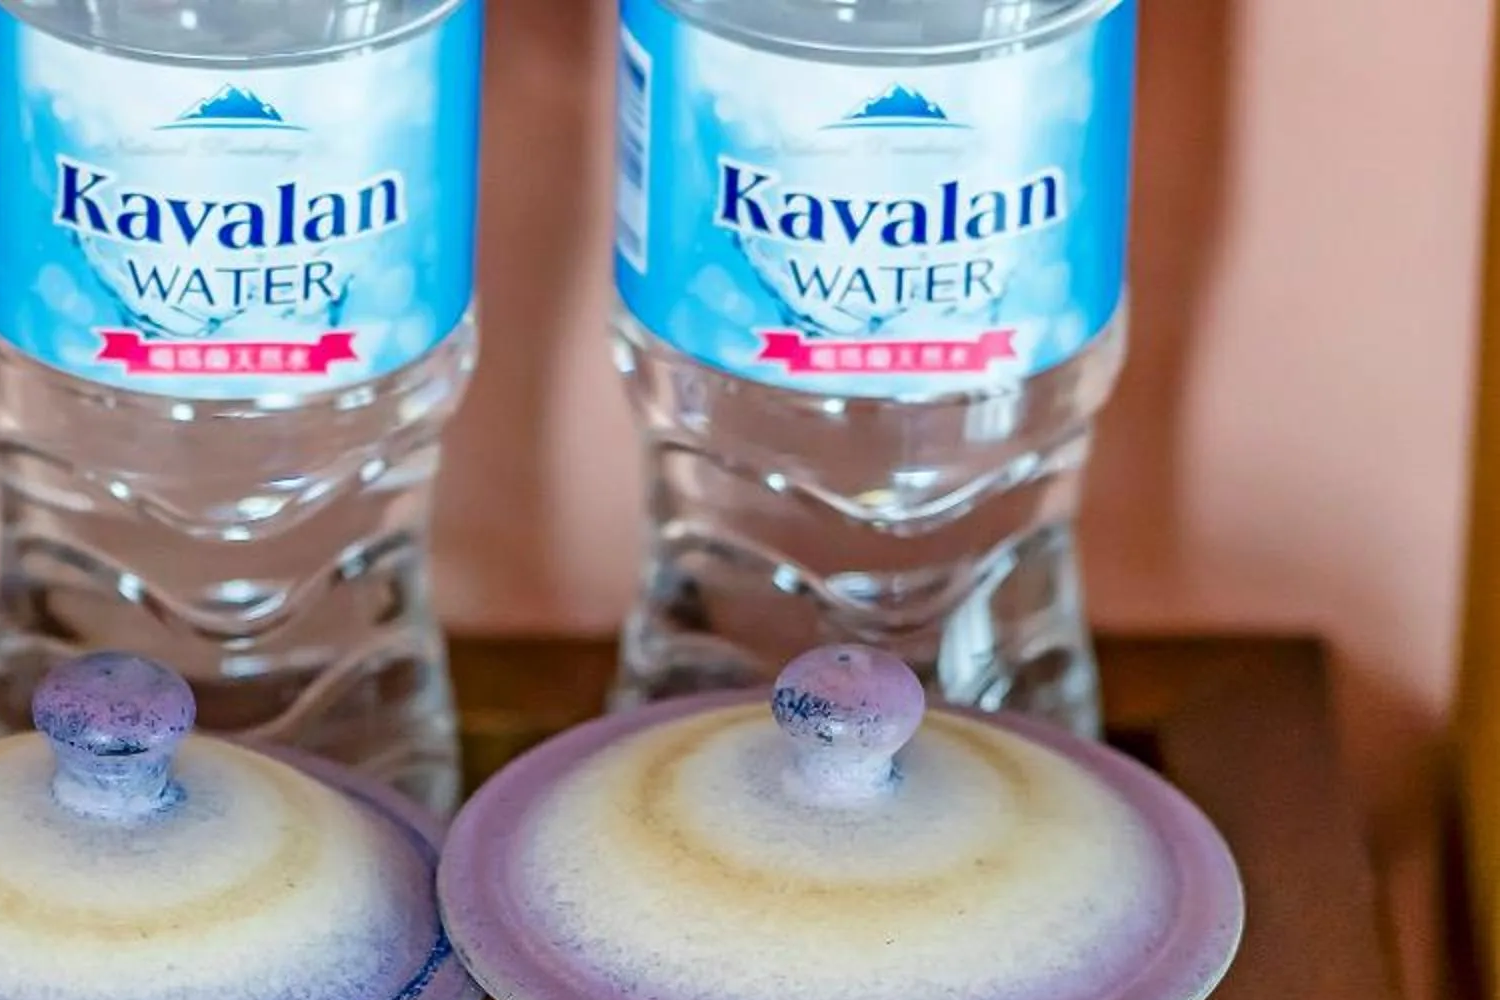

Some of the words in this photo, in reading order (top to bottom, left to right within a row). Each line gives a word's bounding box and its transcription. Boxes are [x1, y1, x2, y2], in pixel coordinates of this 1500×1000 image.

[60, 162, 398, 251] Kavalan
[723, 165, 1057, 247] Kavalan
[127, 260, 336, 306] WATER
[789, 259, 995, 303] WATER
